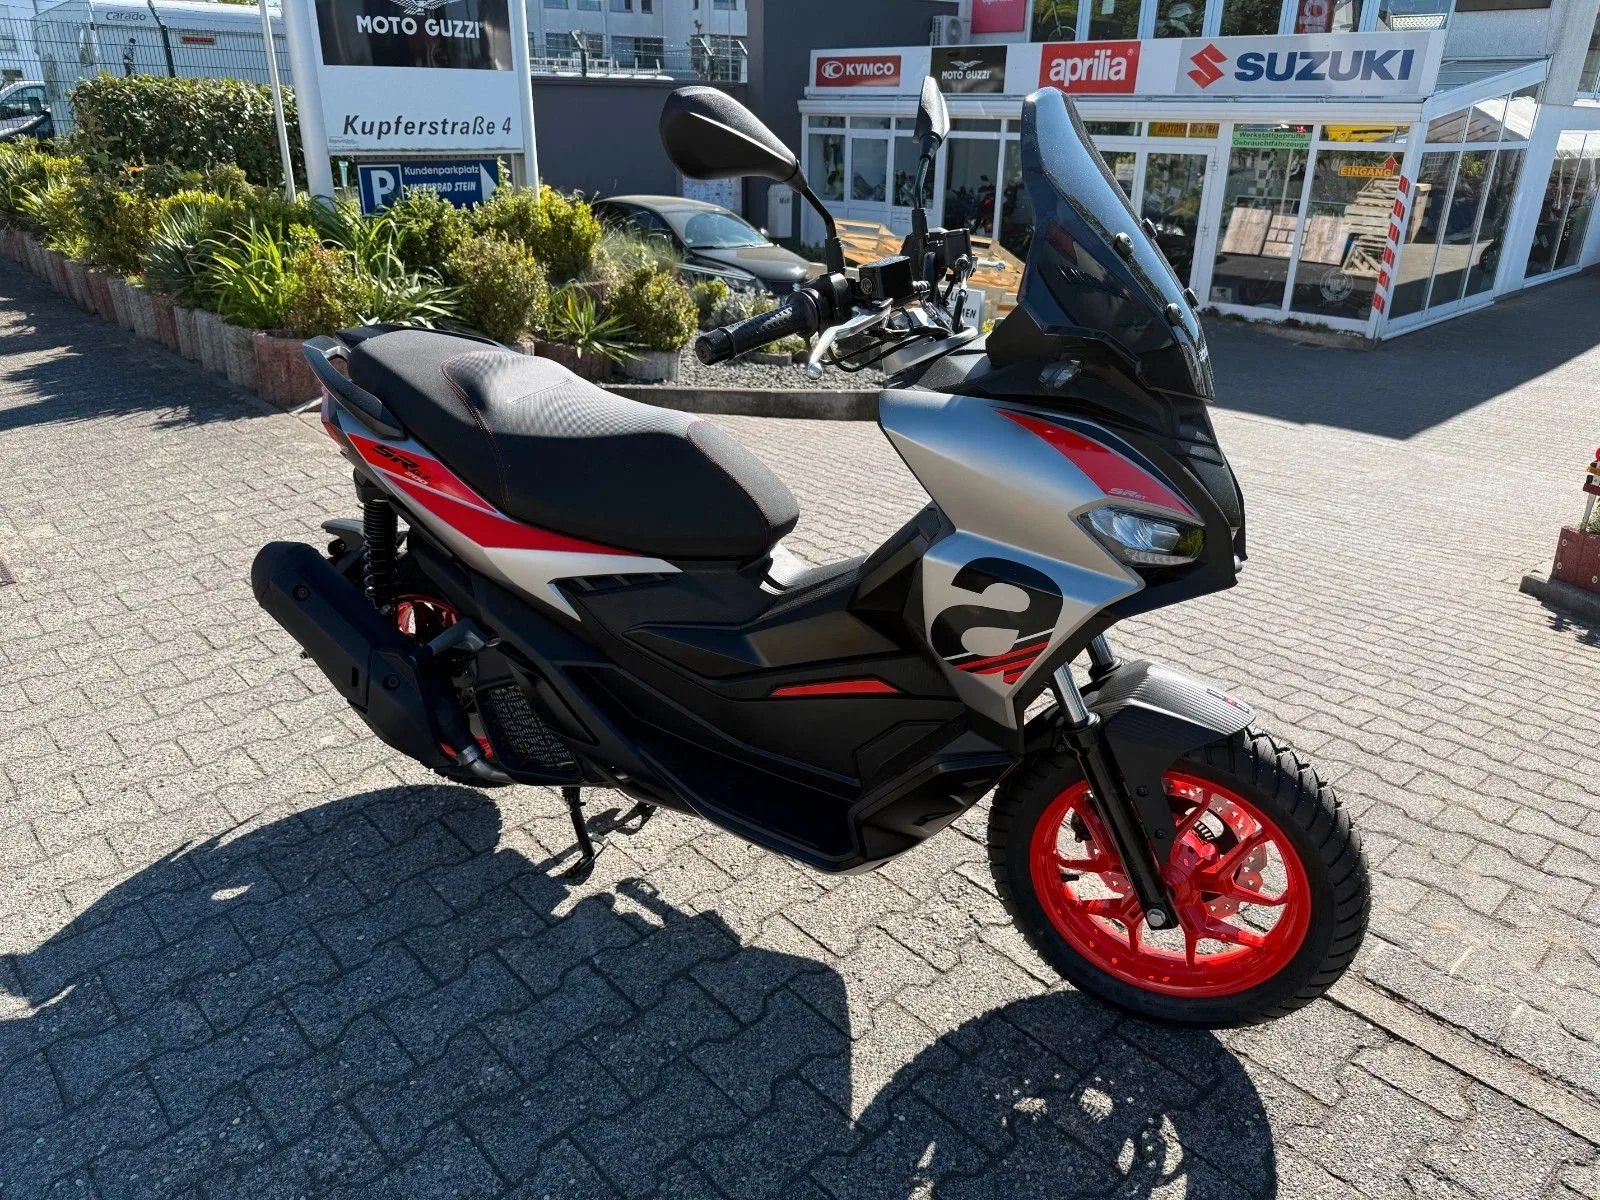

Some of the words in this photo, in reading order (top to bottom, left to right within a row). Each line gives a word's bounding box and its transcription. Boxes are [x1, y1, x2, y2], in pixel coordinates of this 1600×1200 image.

[356, 15, 418, 35] MOTO
[424, 19, 481, 39] GUZZI
[846, 62, 895, 76] KYMCO
[941, 70, 963, 79] MOTO
[966, 70, 990, 79] GUZZI
[1049, 48, 1127, 87] aprilia
[1234, 49, 1415, 82] SUZUKI
[343, 115, 496, 140] Kupferstraße
[502, 117, 512, 134] 4
[404, 165, 480, 176] Kundenparkplatz
[1340, 167, 1391, 177] EINGANG
[370, 169, 396, 206] P
[454, 181, 476, 192] STEIN
